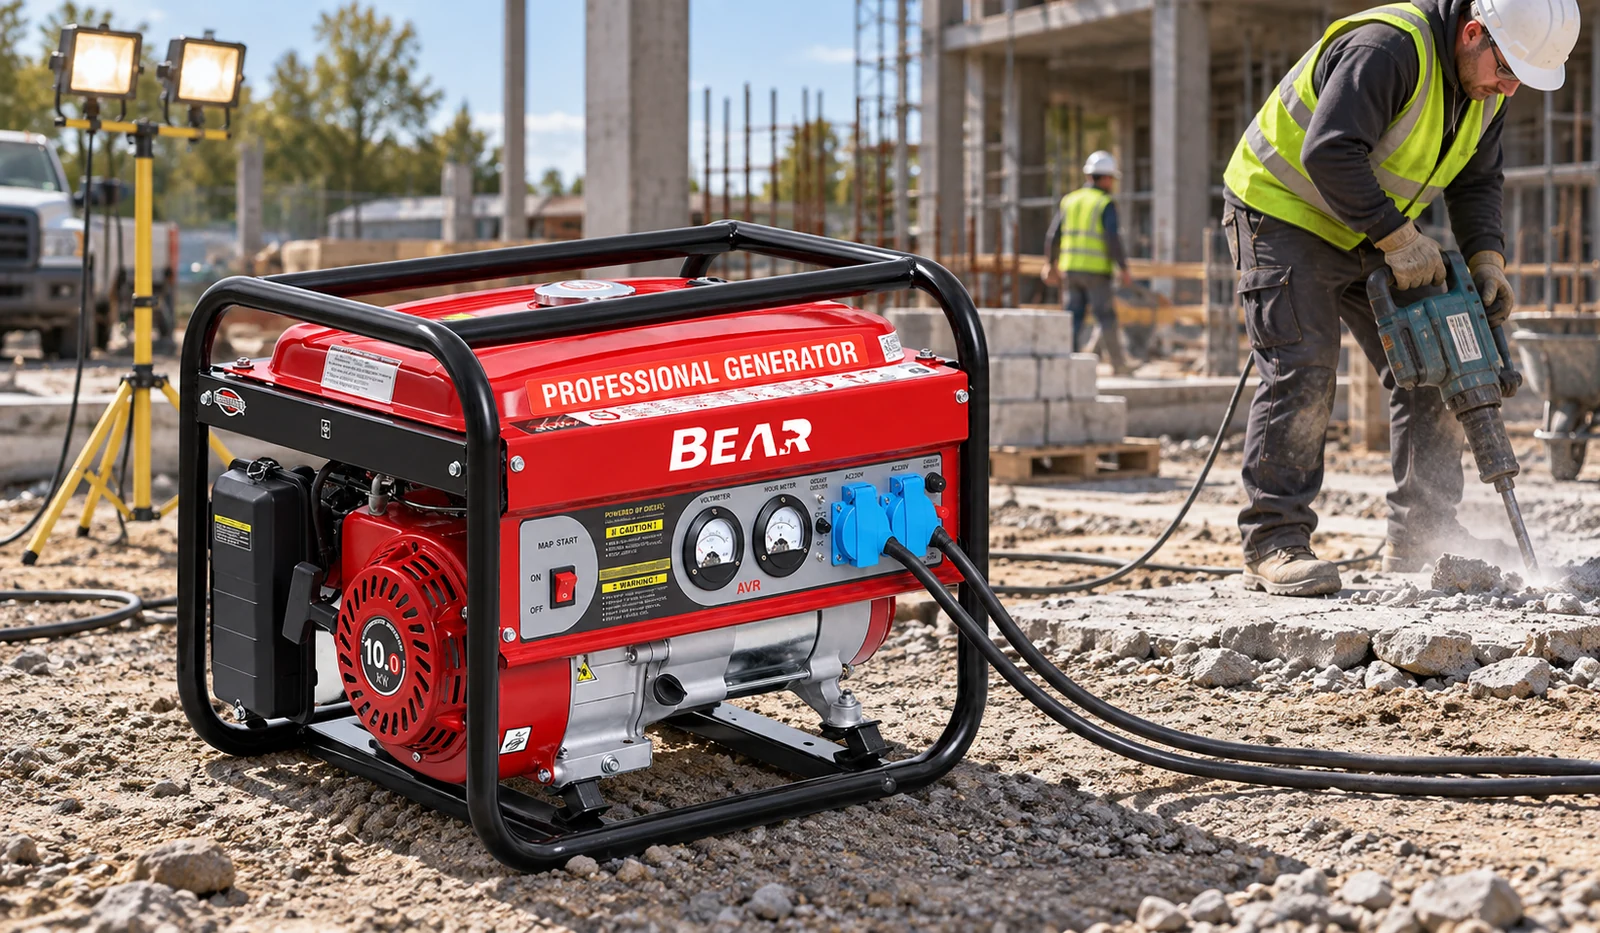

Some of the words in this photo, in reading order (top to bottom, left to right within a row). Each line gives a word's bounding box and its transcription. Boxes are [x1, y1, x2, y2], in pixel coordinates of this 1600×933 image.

[541, 360, 720, 408] PROFESSIONAL
[724, 341, 859, 381] GENERATOR
[669, 418, 812, 472] BEAR
[764, 484, 780, 493] HOUR
[780, 482, 797, 491] METER
[700, 492, 732, 504] VOLTMETER
[538, 540, 554, 550] MAP
[556, 536, 578, 547] START
[530, 573, 542, 582] ON
[737, 579, 761, 595] AVR
[530, 605, 544, 614] OFF
[364, 638, 399, 673] 10.0
